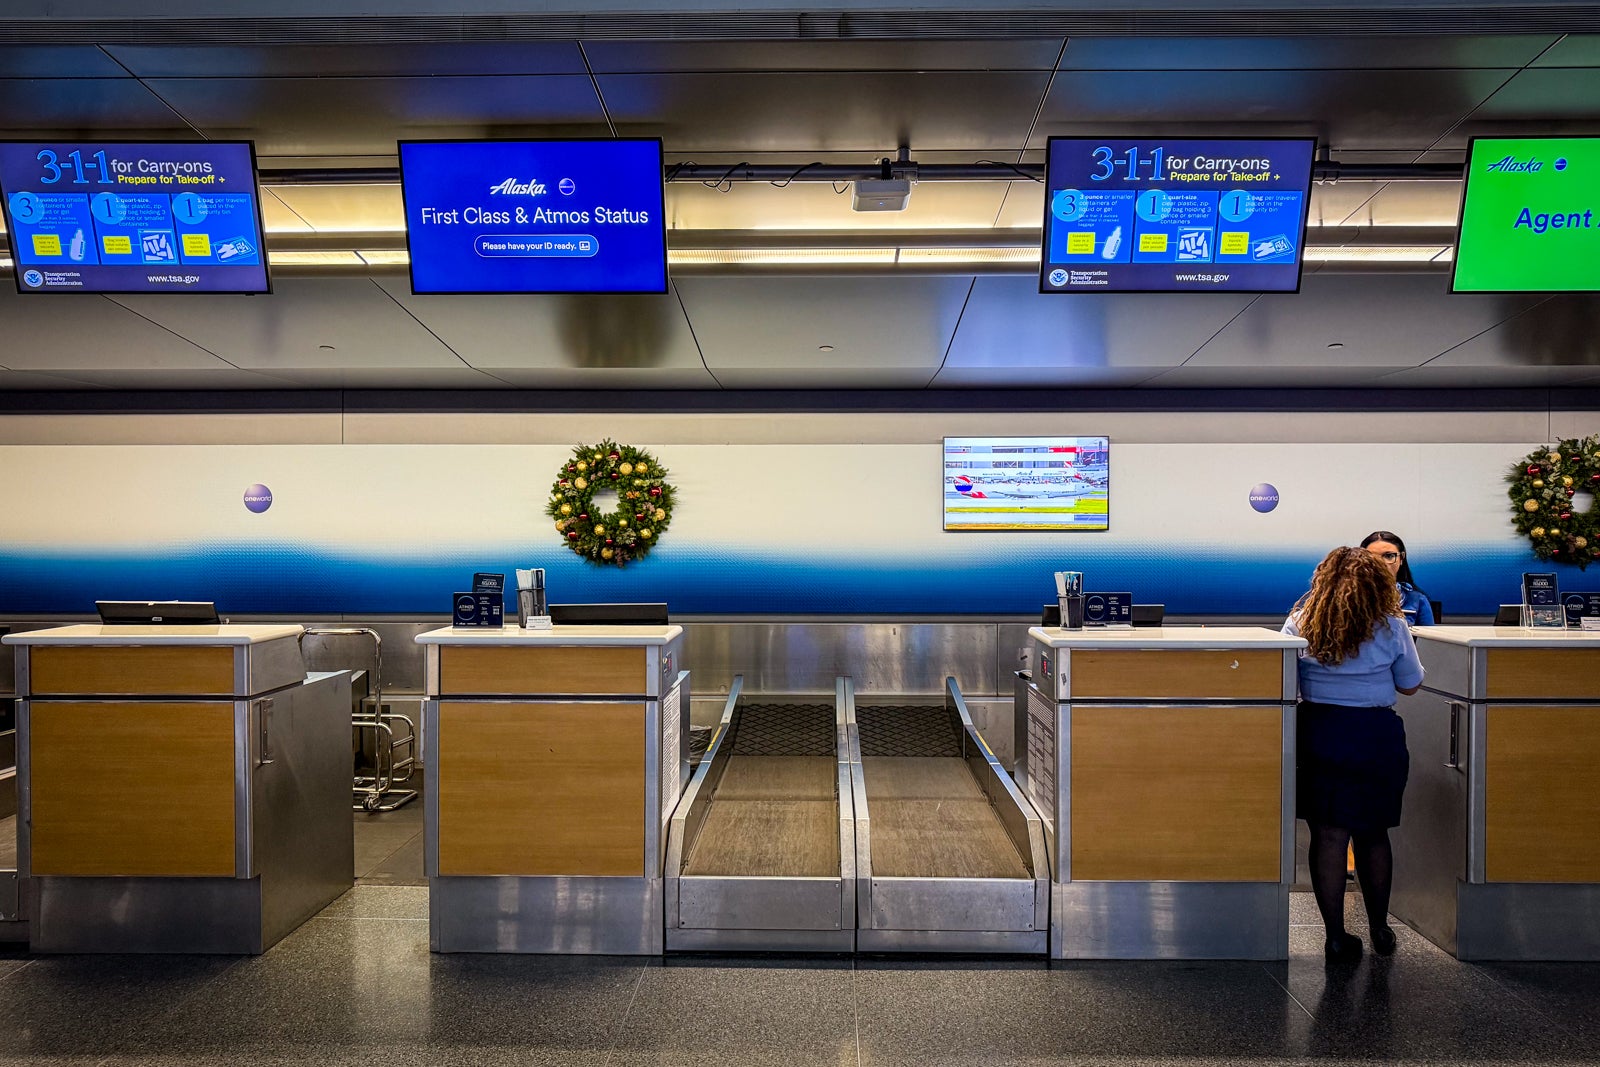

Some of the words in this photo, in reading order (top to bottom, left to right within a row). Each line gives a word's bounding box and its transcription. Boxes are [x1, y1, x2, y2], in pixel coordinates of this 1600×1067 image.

[37, 149, 114, 184] 3-1-1
[111, 159, 133, 173] for
[138, 159, 212, 175] Carry-ons
[1090, 146, 1165, 181] 3-1-1
[1166, 156, 1189, 170] for
[1194, 156, 1270, 172] Carry-ons
[1487, 155, 1544, 173] Alaska
[118, 175, 157, 185] Prepare
[159, 175, 173, 184] for
[177, 175, 215, 184] Take-off
[1170, 172, 1210, 182] Prepare
[1213, 172, 1227, 181] for
[1230, 172, 1270, 181] Take-off
[421, 207, 459, 224] First
[463, 206, 510, 224] Class
[515, 206, 529, 224] &
[533, 206, 590, 224] Atmos
[594, 206, 649, 224] Status
[1513, 207, 1592, 234] Agent
[482, 242, 506, 250] Please
[508, 242, 525, 250] have
[526, 243, 543, 251] your
[544, 242, 552, 250] ID
[554, 242, 577, 251] ready.
[147, 274, 200, 284] www.tsa.gov
[1176, 273, 1230, 282] www.tsa.gov
